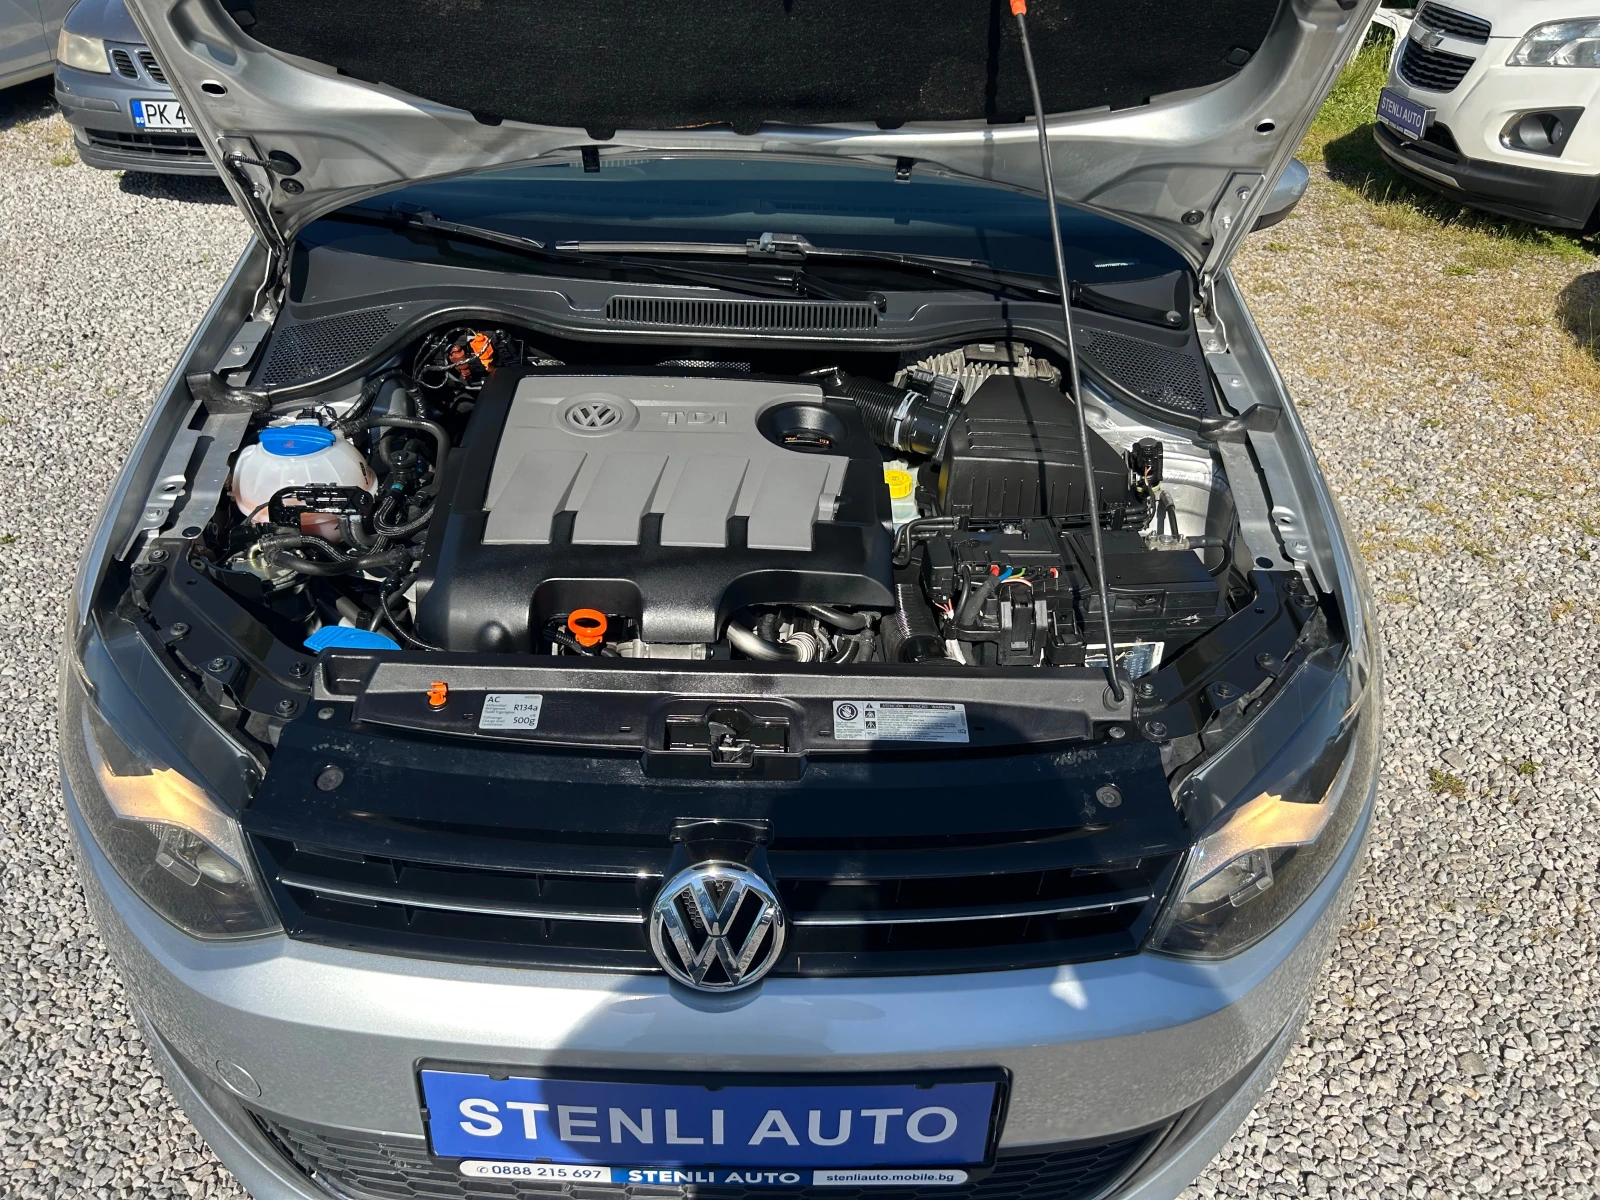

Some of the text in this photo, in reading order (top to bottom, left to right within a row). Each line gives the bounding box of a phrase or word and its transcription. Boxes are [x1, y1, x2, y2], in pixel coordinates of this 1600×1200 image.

[145, 104, 171, 124] PK
[1381, 97, 1403, 118] STENLI
[1402, 108, 1422, 128] AUTO
[661, 410, 728, 426] TDI
[512, 716, 536, 726] 500g
[459, 1098, 958, 1147] STENLI AUTO
[491, 1165, 602, 1180] 0888 215 697
[628, 1169, 801, 1184] STENLI AUTO
[826, 1172, 955, 1182] stenliauto.mobile.bg
